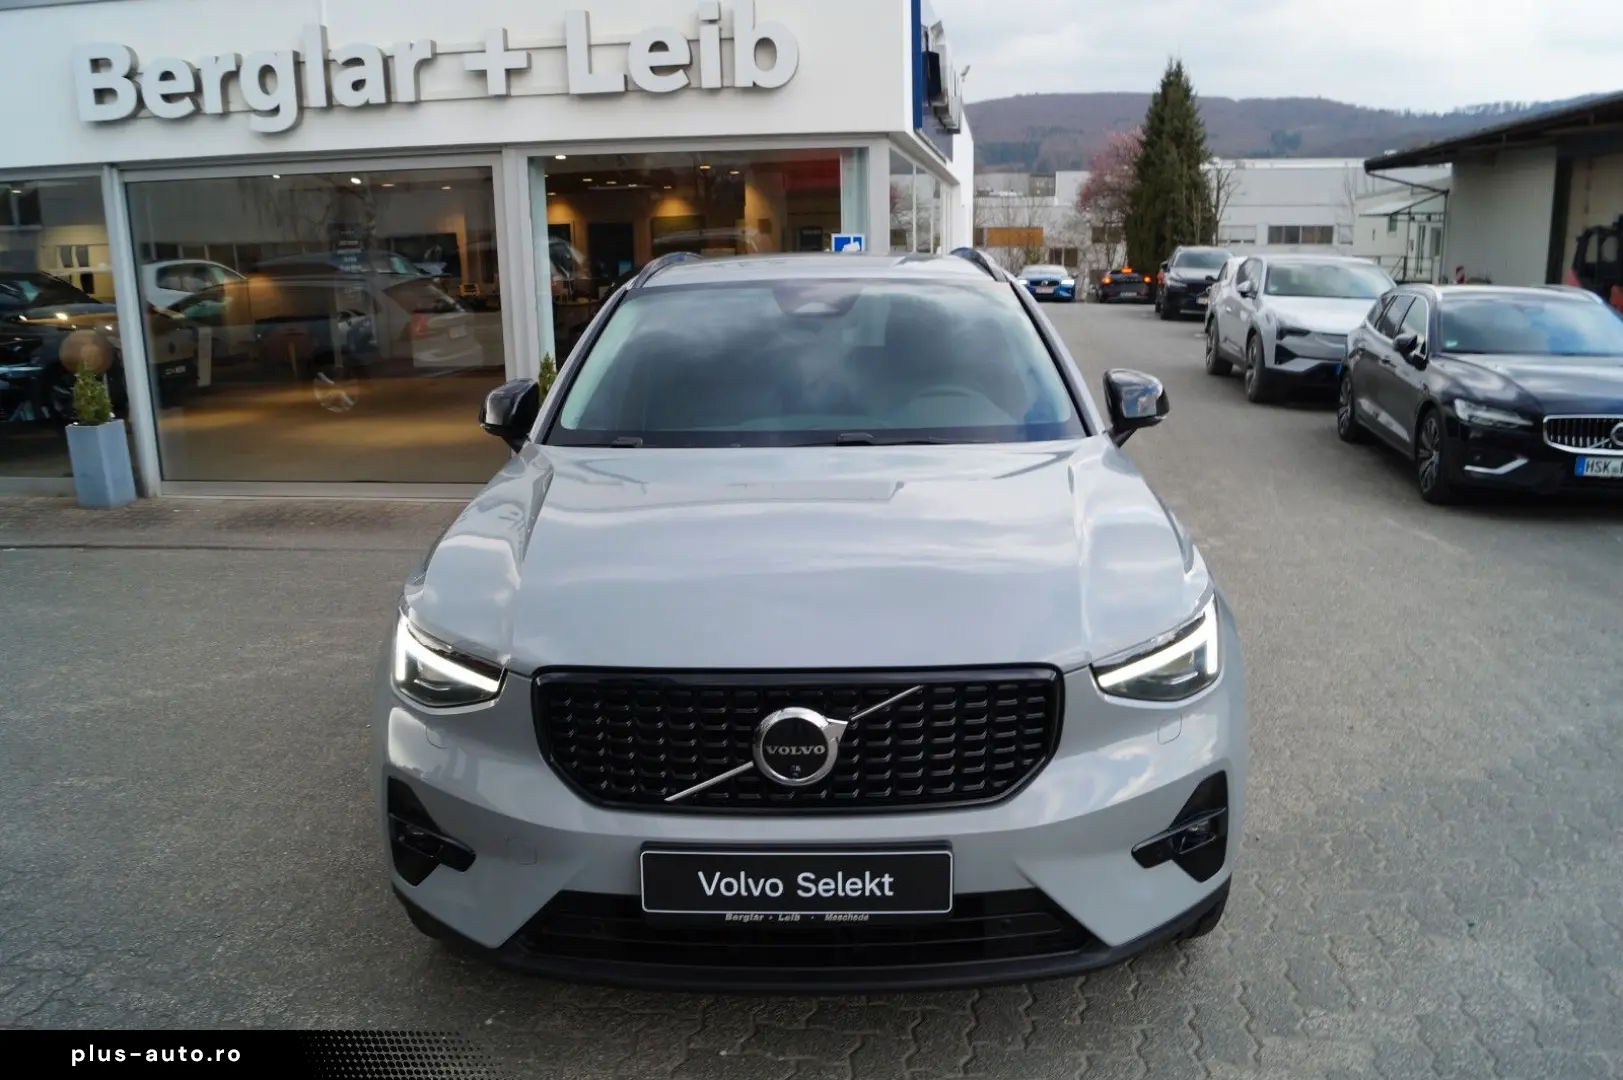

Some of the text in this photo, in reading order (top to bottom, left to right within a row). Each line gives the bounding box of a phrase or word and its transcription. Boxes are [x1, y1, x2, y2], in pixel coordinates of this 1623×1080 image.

[76, 0, 799, 133] Berglar + Leib
[765, 745, 826, 755] VOLVO
[698, 871, 894, 897] Volvo Selekt
[725, 913, 764, 923] Berglar
